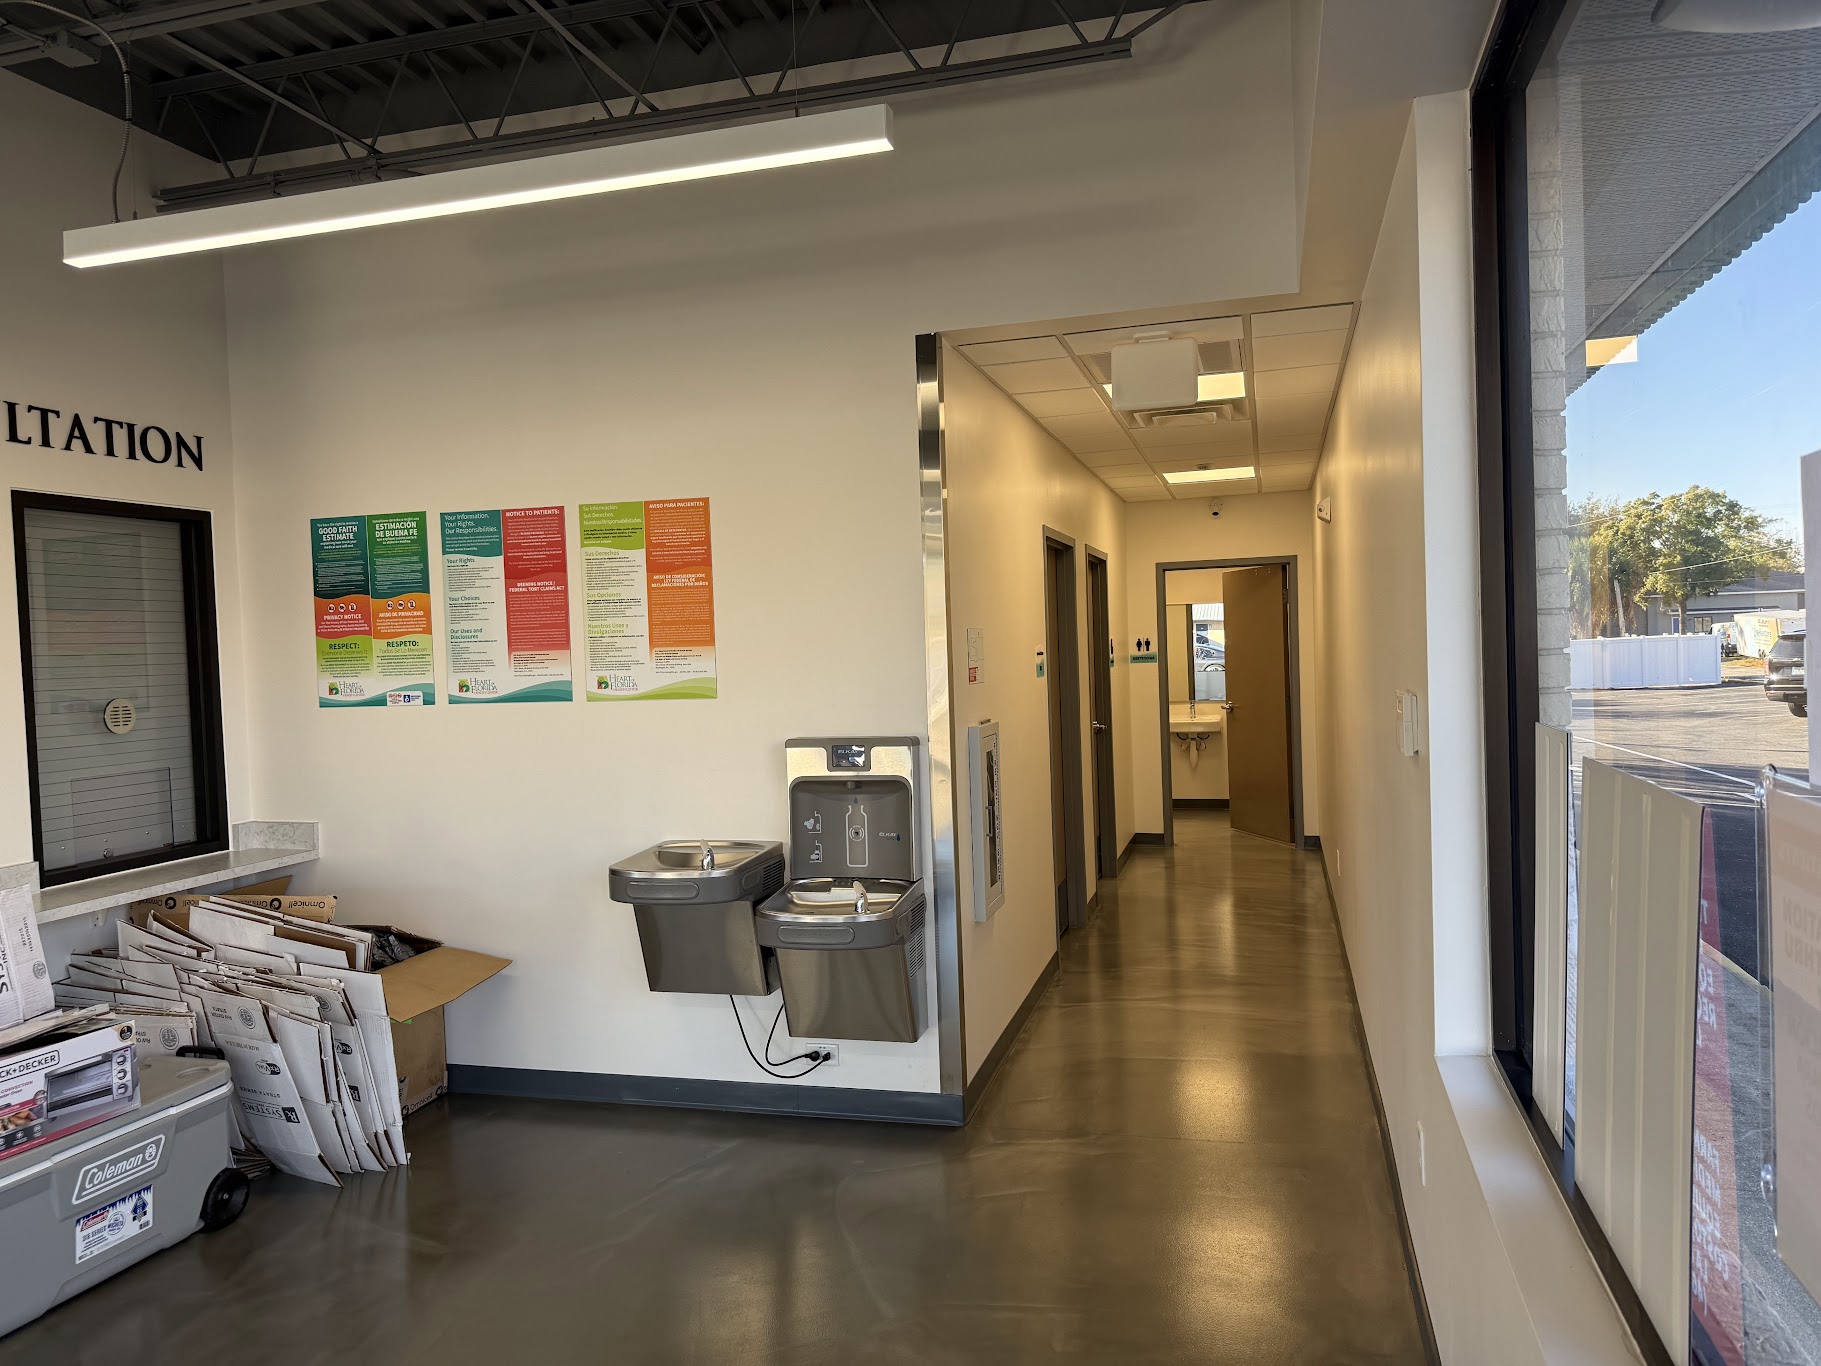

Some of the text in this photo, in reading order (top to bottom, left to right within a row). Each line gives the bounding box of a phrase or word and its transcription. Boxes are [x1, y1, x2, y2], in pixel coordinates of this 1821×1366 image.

[457, 512, 489, 520] Information.
[375, 520, 417, 530] ESTIMACIÓN
[457, 520, 475, 528] Rights.
[319, 525, 358, 535] GOOD FAITH
[386, 529, 408, 537] BUENA
[457, 525, 499, 535] Responsibilities.
[323, 533, 354, 541] ESTIMATE
[459, 557, 475, 565] Rights
[597, 591, 622, 599] Opciones
[387, 640, 419, 648] RESPETO:
[470, 677, 492, 686] HEART
[609, 674, 632, 683] HEART
[471, 684, 498, 695] FLORIDA
[610, 681, 638, 691] FLORIDA
[287, 900, 326, 909] Omnicell
[242, 1102, 282, 1118] SYSTEMS
[84, 1152, 143, 1190] Coleman
